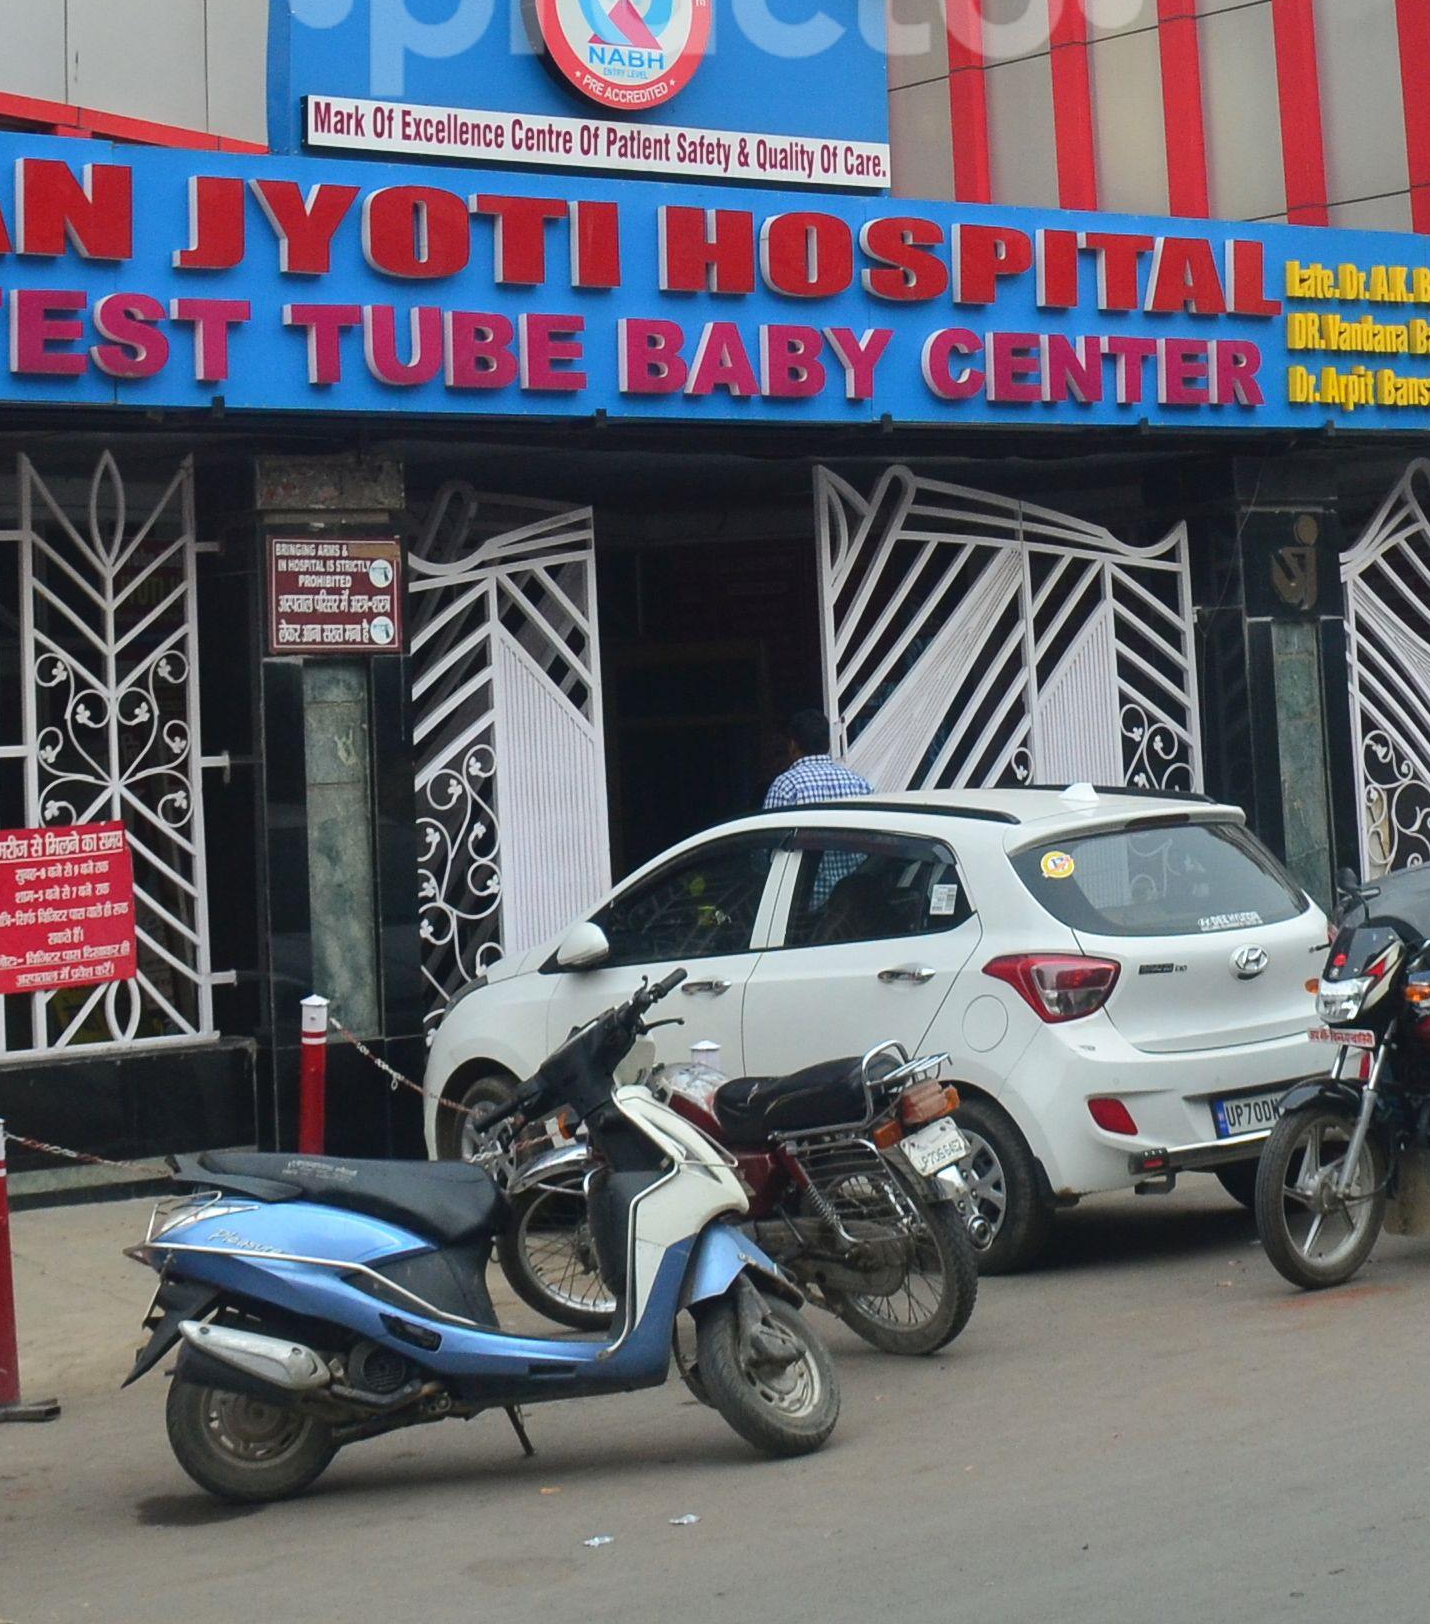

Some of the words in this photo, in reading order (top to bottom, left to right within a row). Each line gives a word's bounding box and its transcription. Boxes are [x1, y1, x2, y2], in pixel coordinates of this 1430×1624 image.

[588, 45, 664, 70] NABH
[582, 76, 603, 96] PRE
[604, 81, 669, 104] ACCREDITED
[313, 100, 367, 139] Mark
[372, 105, 395, 140] Of
[401, 109, 505, 148] Excellence
[511, 119, 573, 156] Centre
[579, 124, 600, 158] Of
[606, 126, 671, 164] Patient
[676, 133, 731, 173] Safety
[737, 136, 750, 168] &
[755, 139, 815, 179] Quality
[820, 143, 840, 175] Of
[843, 146, 888, 178] Care.
[172, 175, 622, 288] JYOTI
[658, 204, 1282, 317] HOSPITAL
[1286, 260, 1340, 299] Late.
[1338, 263, 1369, 301] Dr.
[1371, 265, 1414, 303] A.K.
[282, 302, 587, 391] TUBE
[618, 318, 895, 399] BABY
[921, 326, 1265, 407] CENTER
[1288, 365, 1320, 403] Dr.
[1321, 365, 1374, 411] Arpit
[288, 559, 325, 572] HOSPITAL
[326, 560, 334, 572] IS
[335, 560, 371, 573] STRICTLY
[298, 575, 352, 588] PROHIBITED
[31, 834, 43, 857] से
[81, 833, 97, 852] का
